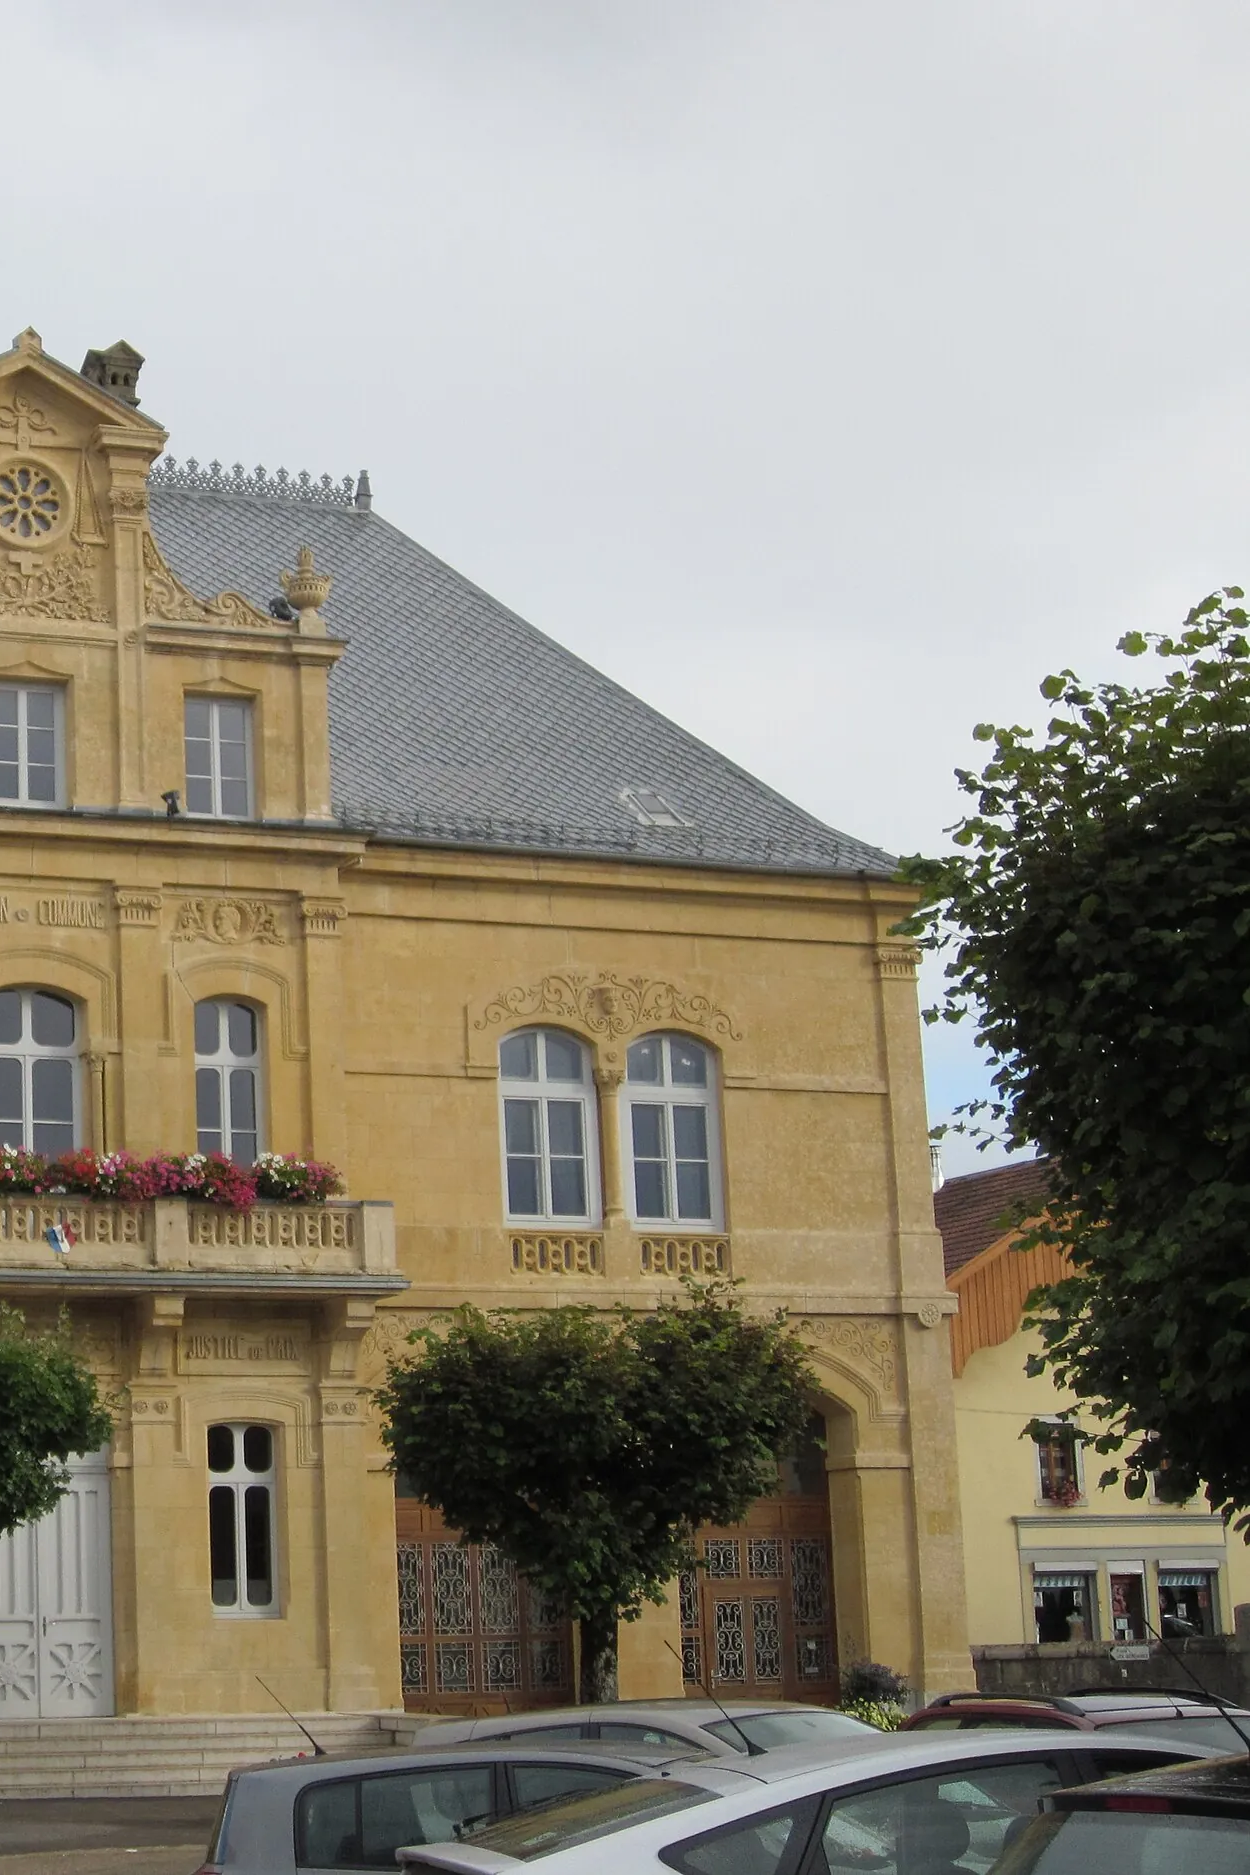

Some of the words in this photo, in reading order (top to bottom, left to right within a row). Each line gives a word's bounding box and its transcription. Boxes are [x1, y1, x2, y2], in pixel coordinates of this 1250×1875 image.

[36, 899, 104, 929] COMMUNE
[187, 1335, 247, 1360] JUSTICE
[267, 1336, 301, 1361] PAIX
